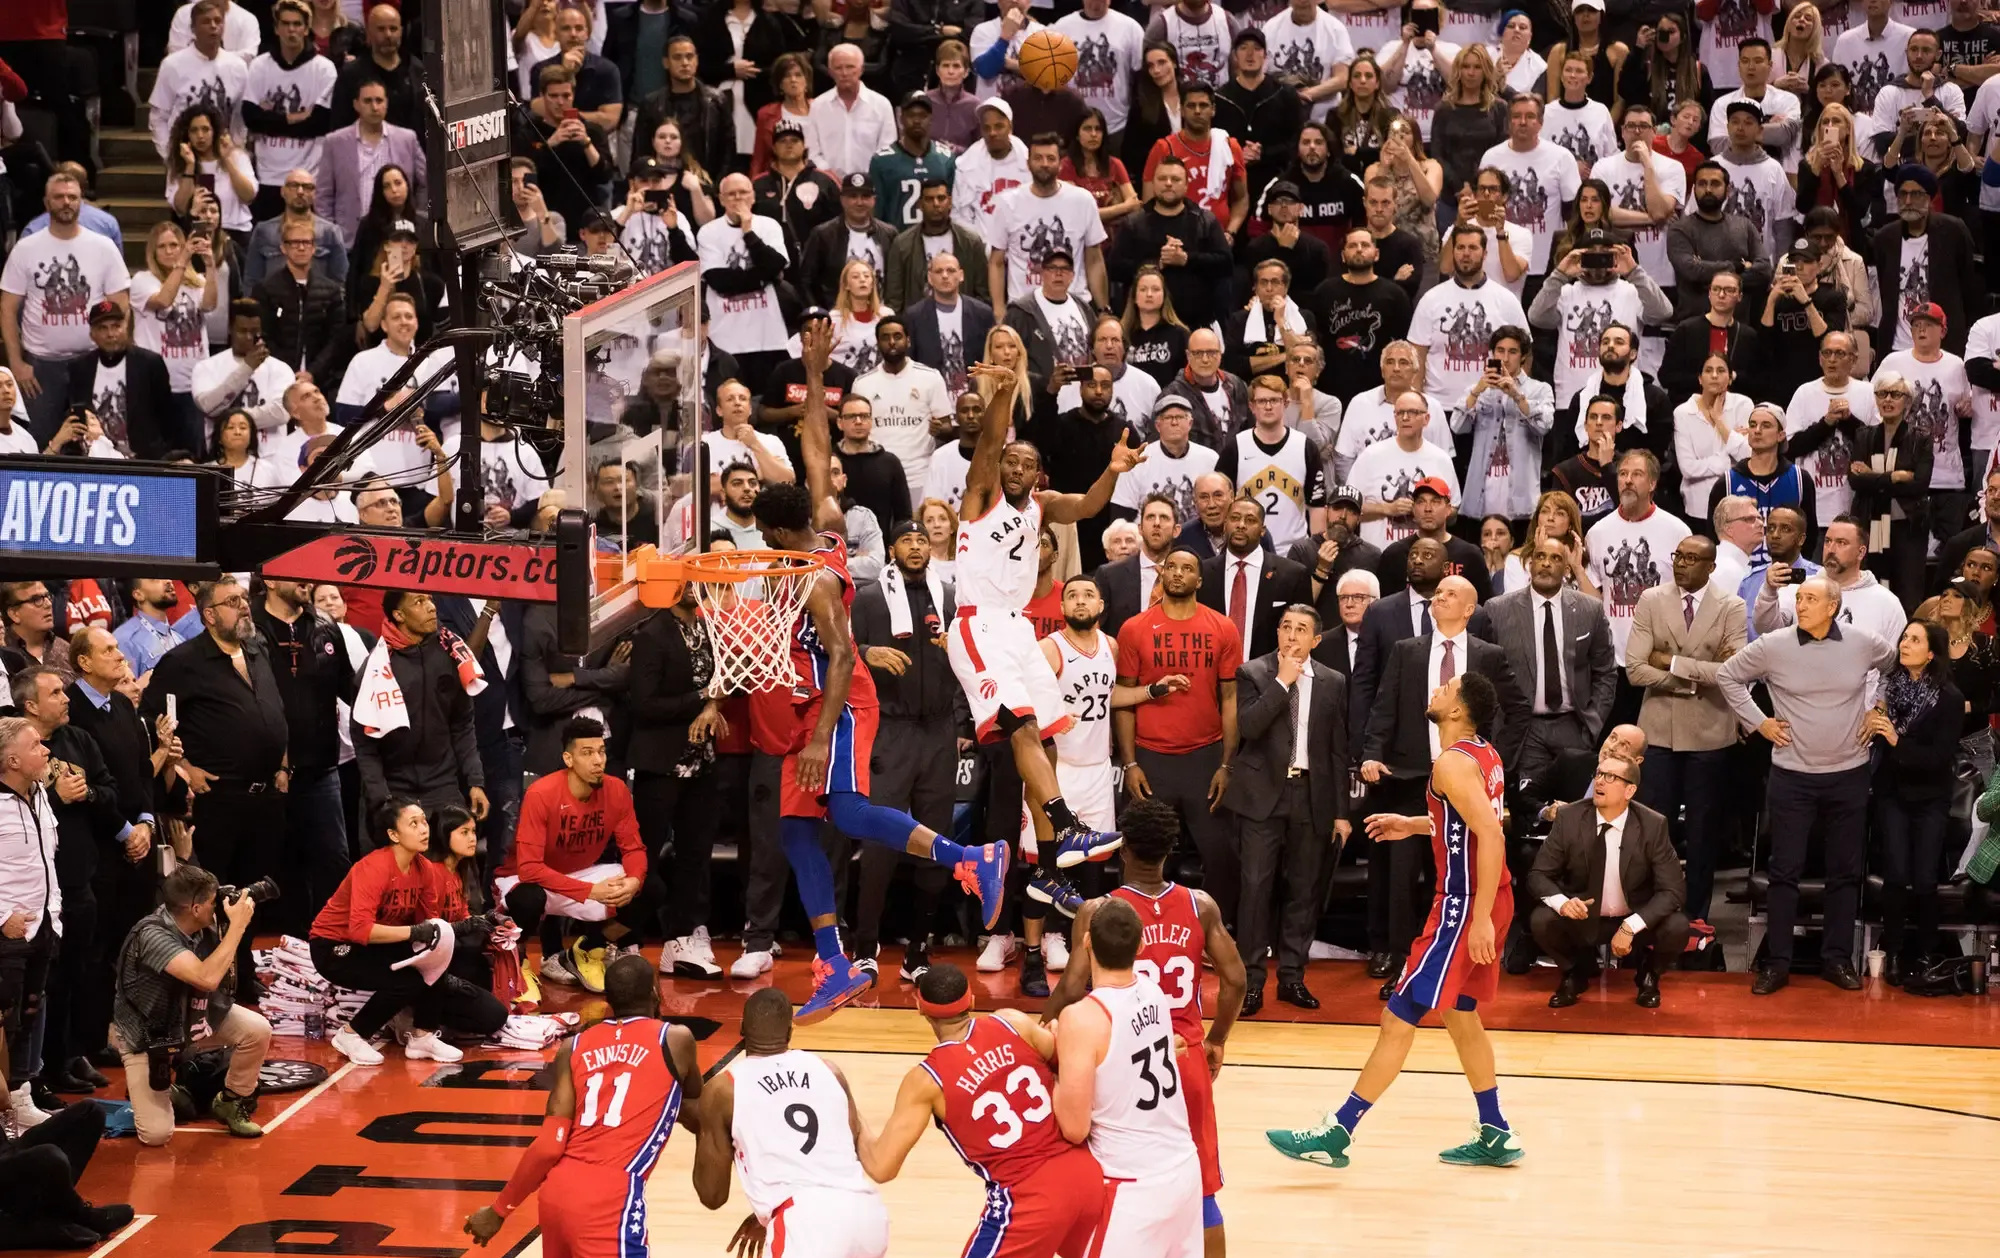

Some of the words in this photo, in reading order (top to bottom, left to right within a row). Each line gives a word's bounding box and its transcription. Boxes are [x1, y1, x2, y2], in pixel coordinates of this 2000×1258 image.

[1943, 40, 1960, 53] WE
[1963, 39, 1990, 53] THE
[465, 109, 507, 146] TISSOT
[1569, 356, 1599, 369] NOR
[874, 415, 923, 429] Emirates
[890, 406, 905, 416] Fly
[1814, 474, 1845, 489] NOR
[0, 479, 139, 547] AYOFFS
[1265, 492, 1279, 516] 2
[1010, 534, 1025, 562] 2
[1609, 604, 1637, 618] NOR
[1153, 633, 1174, 650] WE
[1180, 632, 1214, 650] THE
[1153, 652, 1214, 670] NORTH
[1080, 693, 1109, 723] 23
[555, 829, 606, 848] NORTH
[1141, 923, 1191, 948] UTLER
[1131, 1004, 1165, 1037] GASOL
[582, 1043, 628, 1071] ENNIS
[956, 1043, 1017, 1096] HARRIS
[757, 1071, 811, 1096] IBAKA
[1131, 1035, 1177, 1111] 33
[580, 1071, 632, 1128] 11
[971, 1064, 1052, 1149] 33
[784, 1102, 819, 1155] 9
